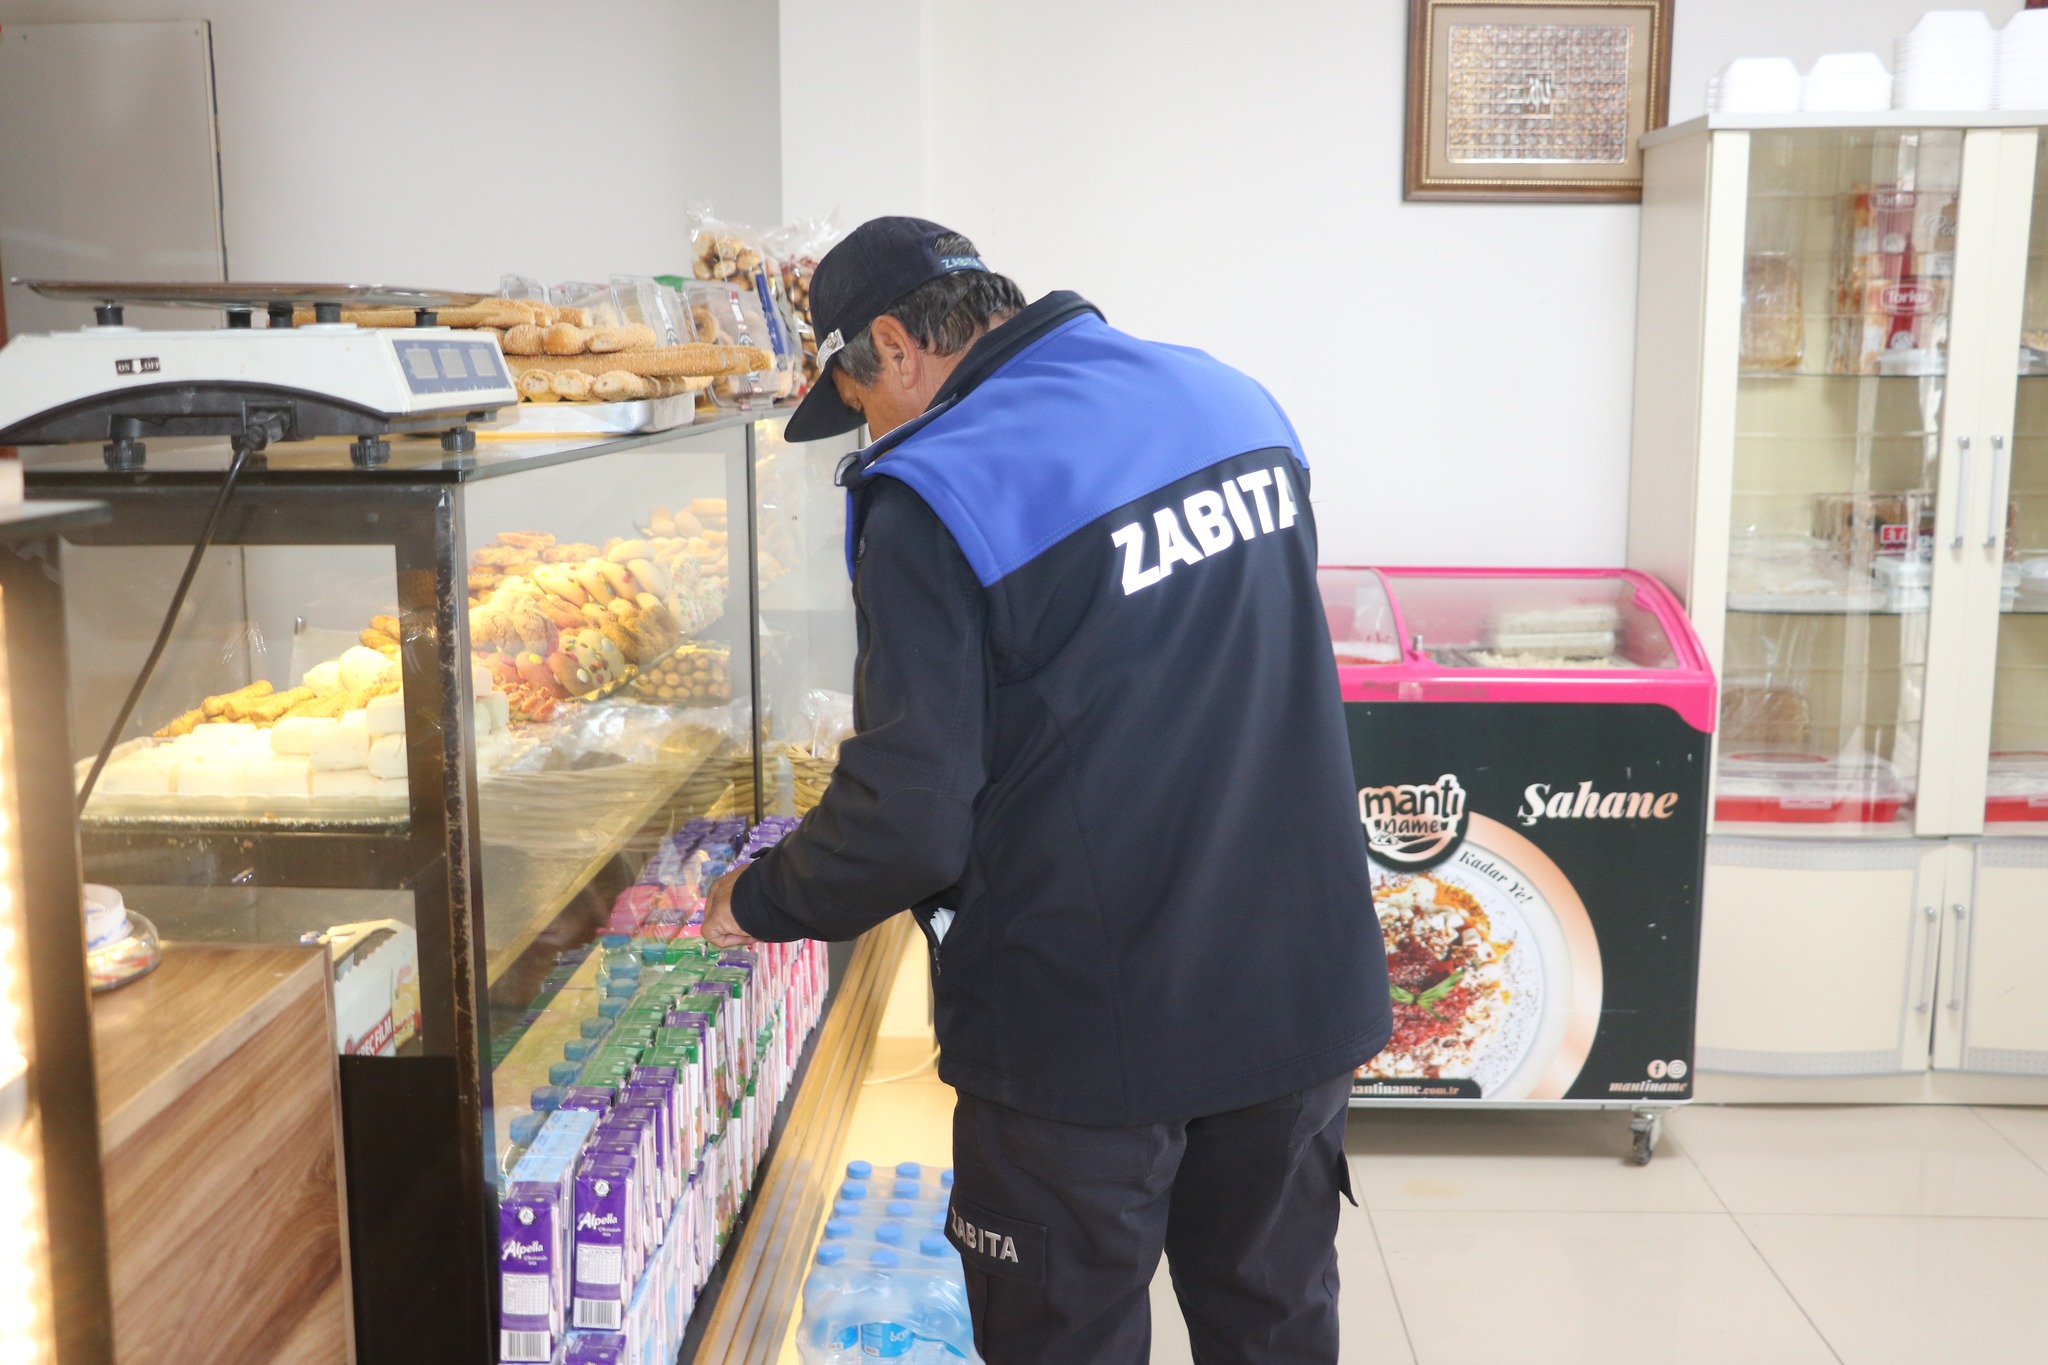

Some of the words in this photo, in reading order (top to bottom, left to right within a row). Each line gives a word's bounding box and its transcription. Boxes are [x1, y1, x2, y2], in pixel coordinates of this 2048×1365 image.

[1887, 289, 1928, 304] Torku
[1110, 466, 1299, 596] ZABITA
[1516, 780, 1679, 827] Şahane
[1384, 818, 1439, 834] name
[1458, 850, 1508, 882] Kadar
[1508, 881, 1534, 904] Ye!
[1608, 1079, 1689, 1092] mantiname
[577, 1211, 618, 1231] Alpella
[951, 1206, 1019, 1263] ZABITA
[502, 1239, 544, 1261] Alpella
